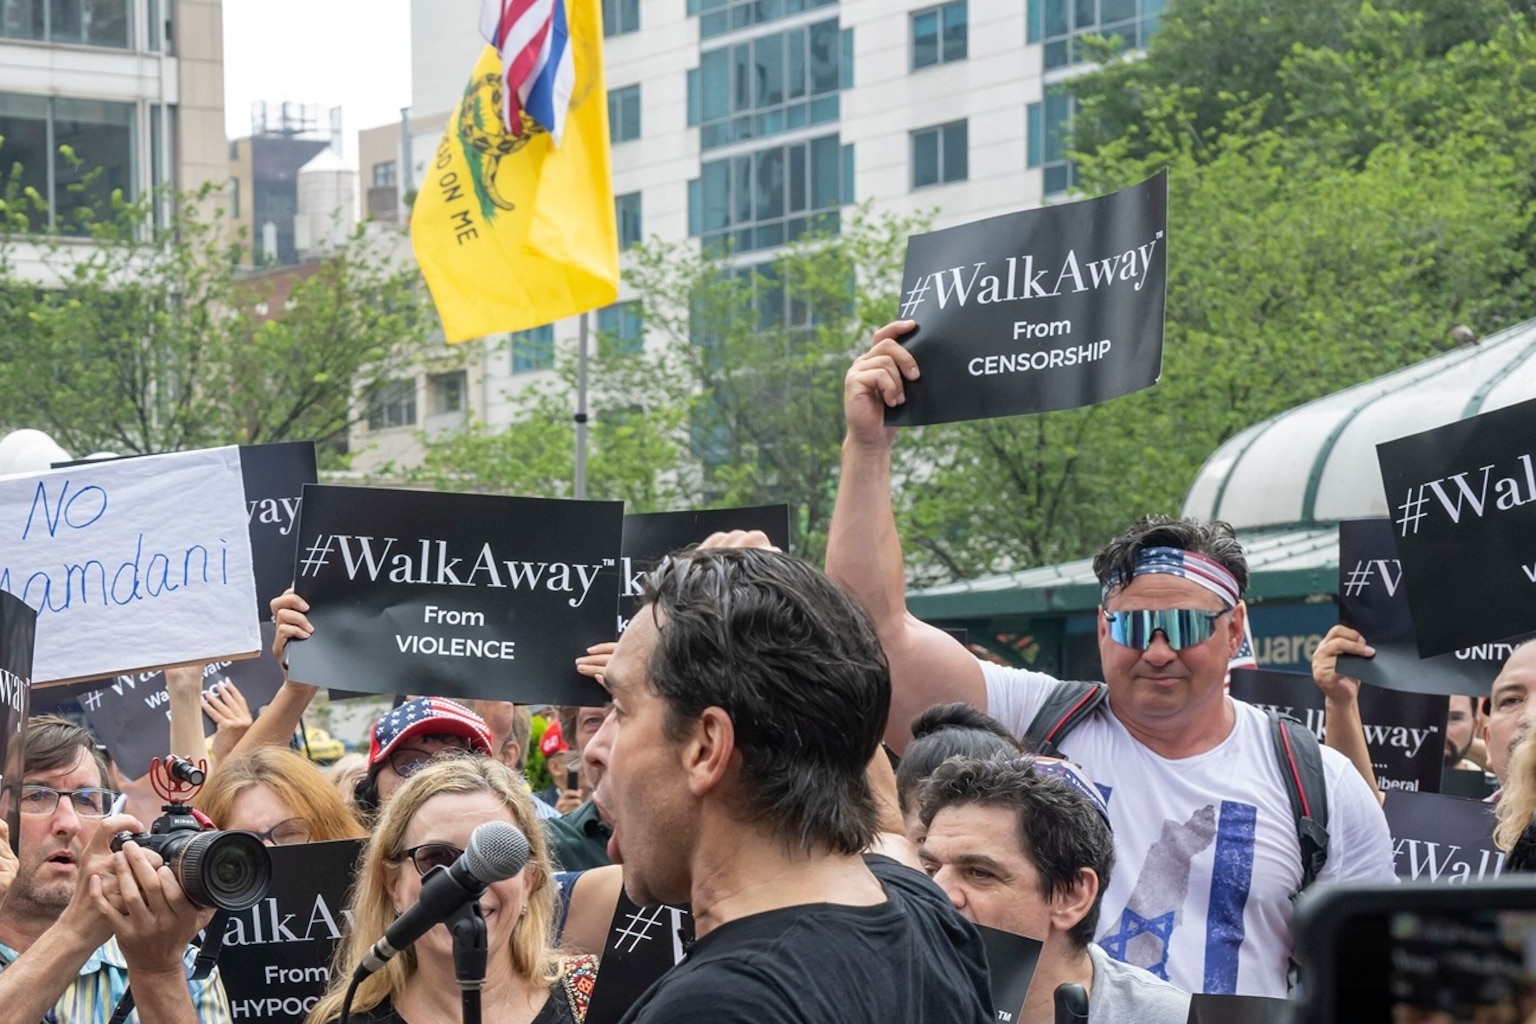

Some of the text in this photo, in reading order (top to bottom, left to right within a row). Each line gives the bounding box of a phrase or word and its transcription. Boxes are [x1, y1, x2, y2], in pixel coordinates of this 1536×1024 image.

[439, 171, 465, 204] ON
[450, 209, 480, 246] ME
[1013, 319, 1072, 341] From
[967, 339, 1113, 377] CENSORSHIP
[21, 479, 109, 541] NO
[423, 604, 486, 627] From
[395, 634, 516, 660] VIOLENCE
[264, 965, 329, 985] From
